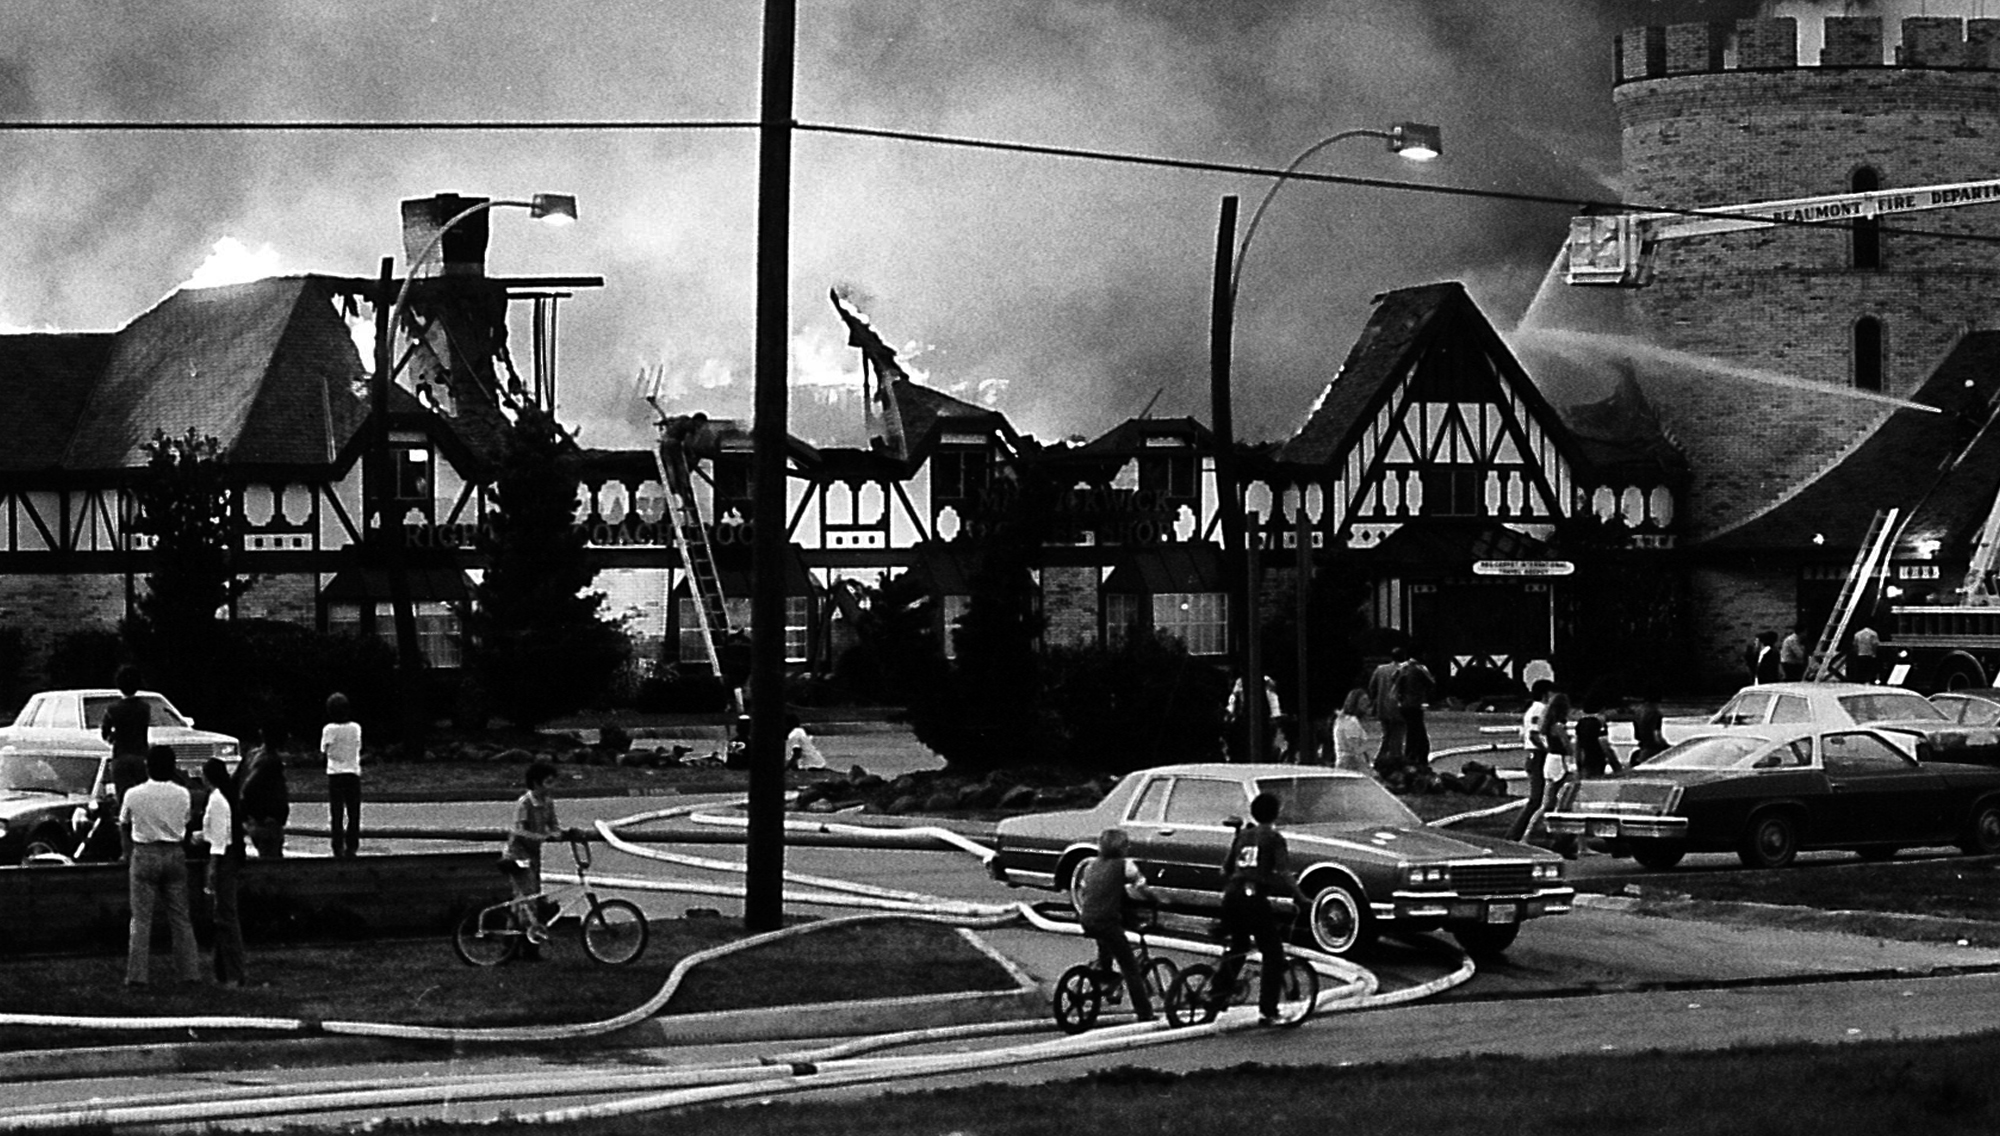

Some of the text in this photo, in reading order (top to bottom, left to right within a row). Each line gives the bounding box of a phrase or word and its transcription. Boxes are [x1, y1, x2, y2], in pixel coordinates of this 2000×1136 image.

[1773, 202, 1862, 222] BEAUMONT
[1878, 196, 1916, 211] FIRE
[1052, 489, 1170, 512] ICKWICK
